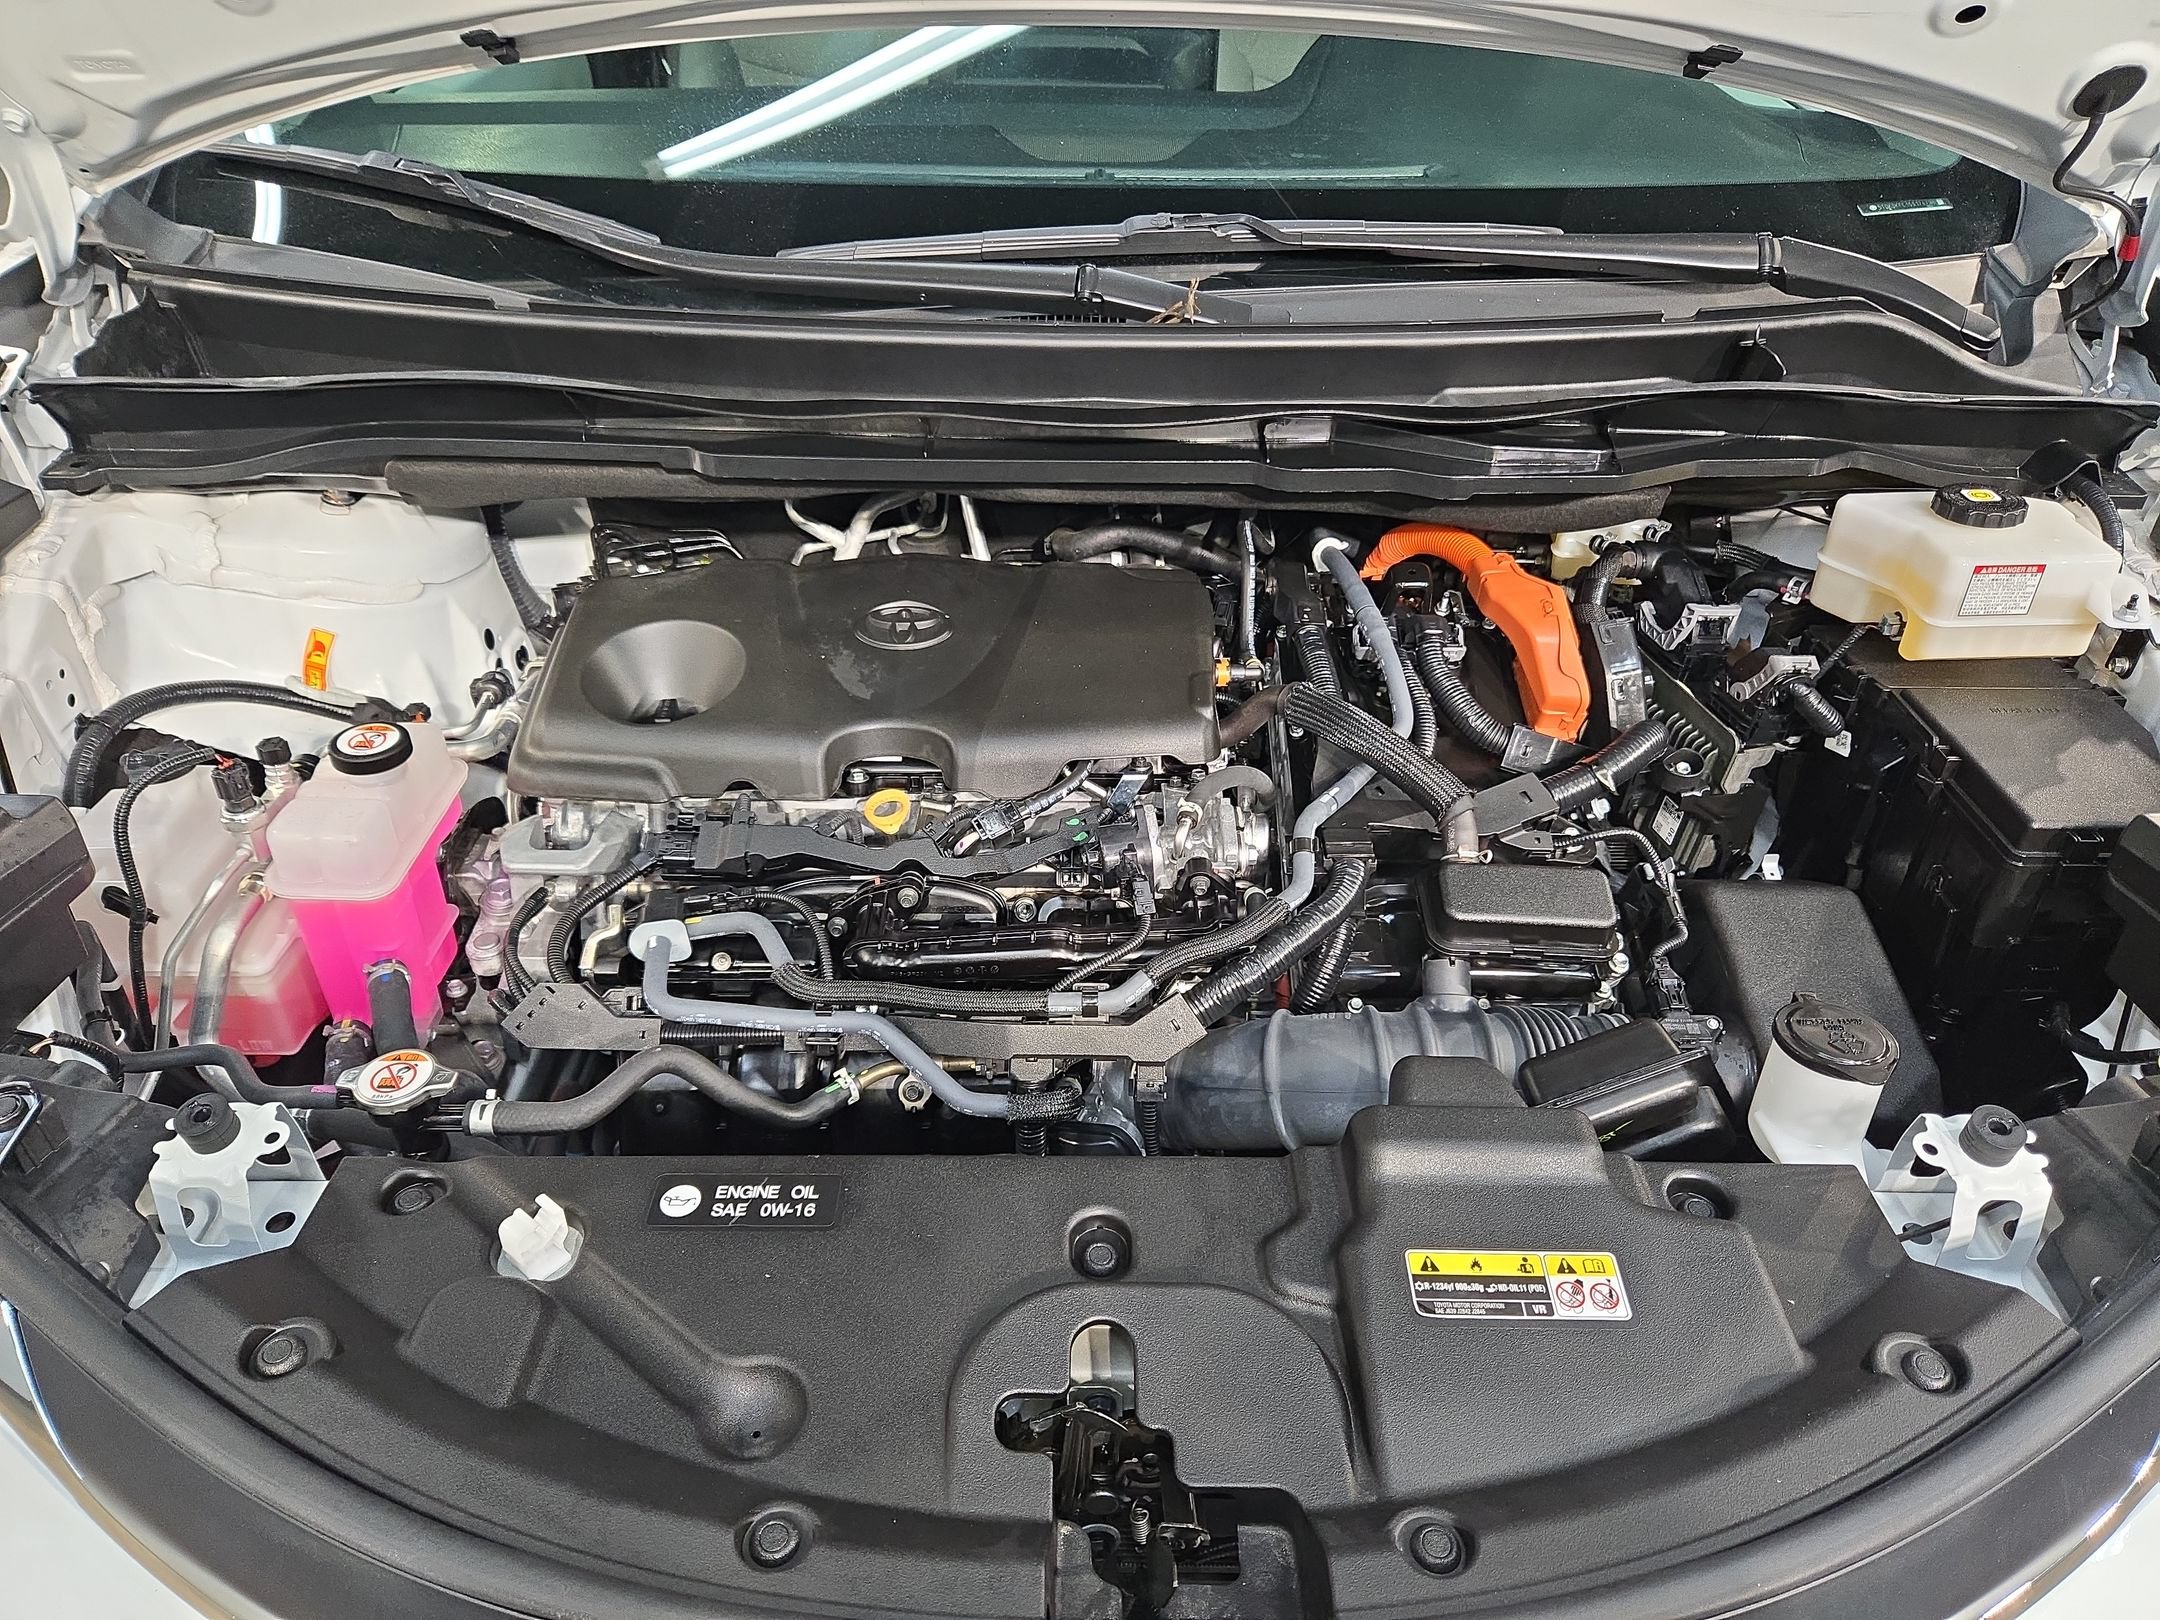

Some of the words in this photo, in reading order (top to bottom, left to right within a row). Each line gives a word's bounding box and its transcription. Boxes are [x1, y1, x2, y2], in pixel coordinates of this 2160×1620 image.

[715, 1185, 782, 1199] ENGINE
[790, 1185, 819, 1199] OIL
[710, 1202, 748, 1217] SAE
[760, 1202, 816, 1217] 0W-16
[1423, 1282, 1454, 1292] R-1234yf
[1497, 1283, 1527, 1293] ND-OIL11
[1528, 1283, 1546, 1294] (POE)
[1532, 1304, 1547, 1314] VR
